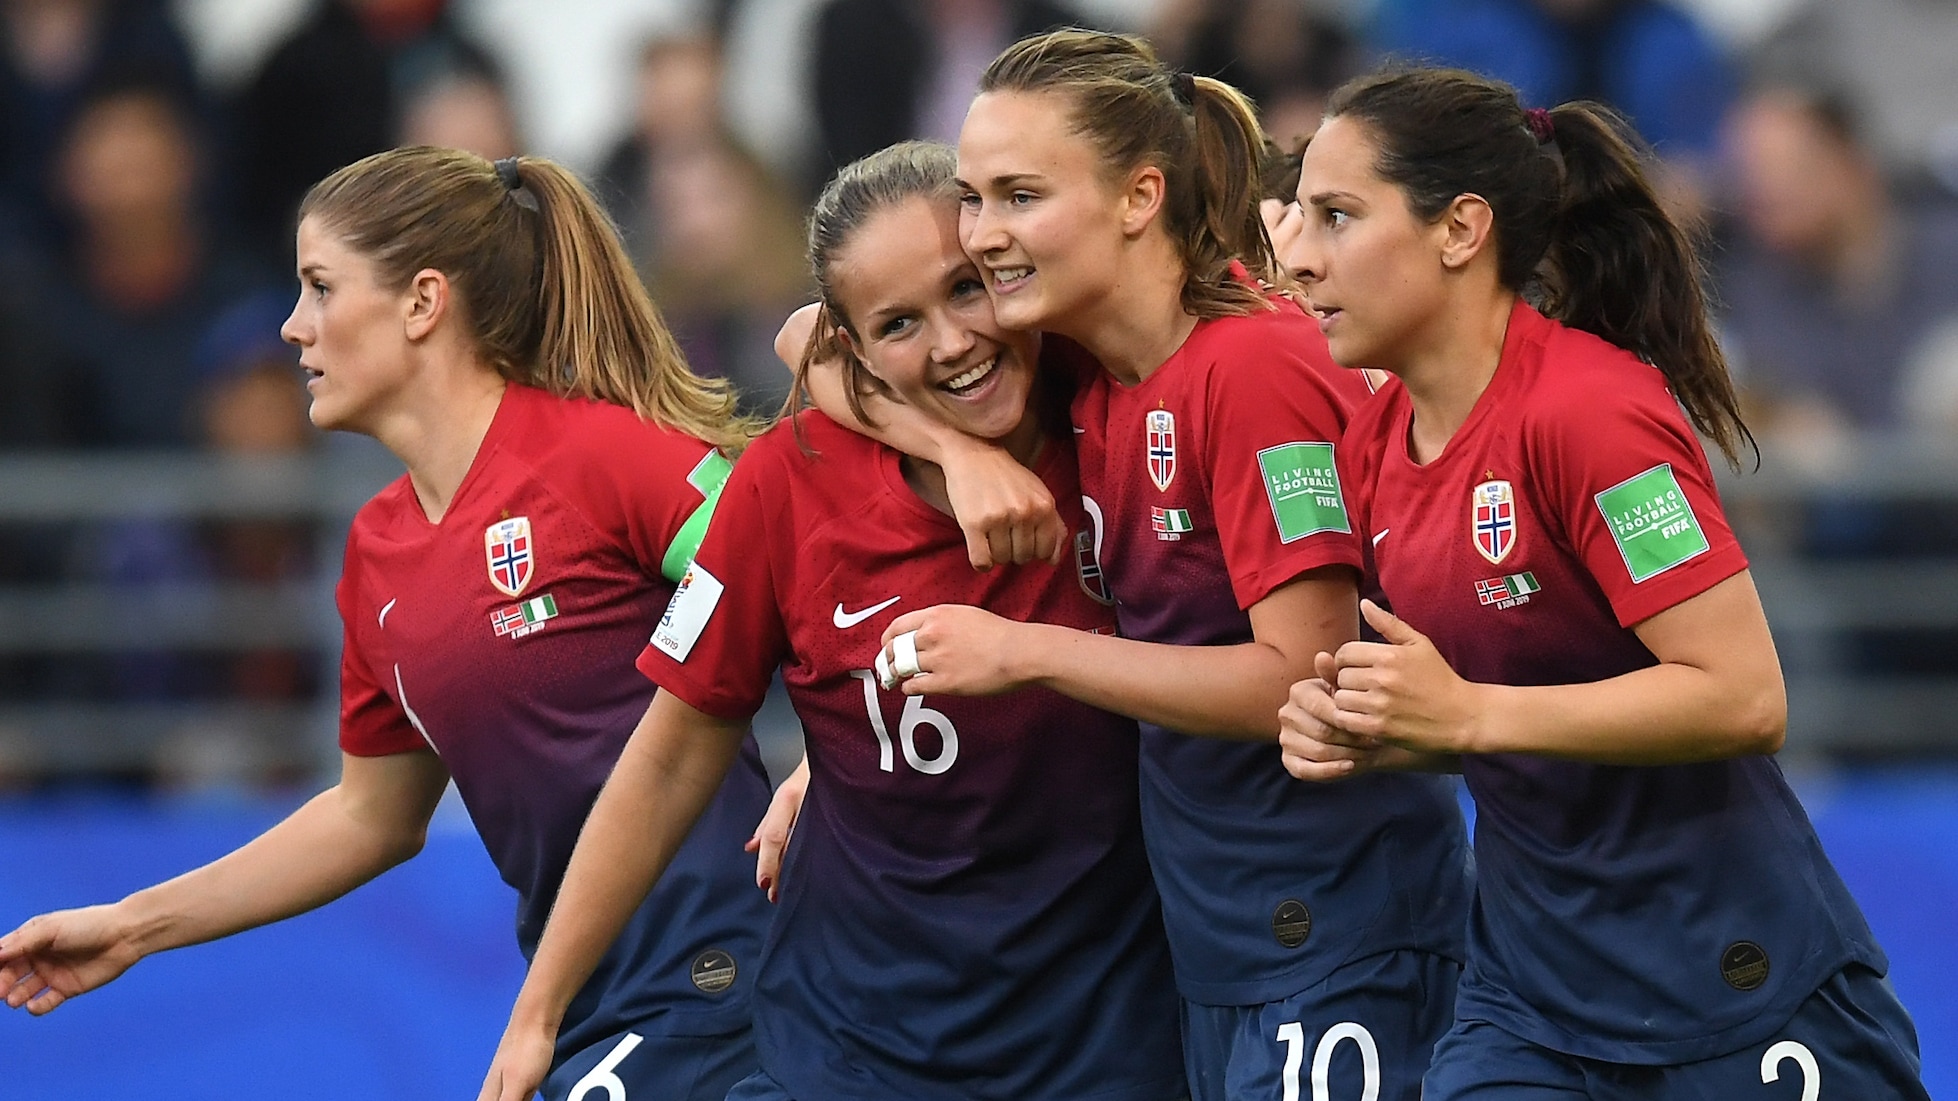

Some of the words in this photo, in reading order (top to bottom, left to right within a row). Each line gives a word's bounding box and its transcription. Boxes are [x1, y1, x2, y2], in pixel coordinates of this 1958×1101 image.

[1271, 467, 1332, 485] LIVING
[1274, 477, 1335, 494] FOOTBALL
[1315, 495, 1340, 508] FIFA
[1612, 490, 1677, 526] LIVING
[1617, 500, 1681, 535] FOOTBALL
[1661, 517, 1691, 540] FIFA
[660, 635, 679, 650] 2019
[850, 668, 959, 775] 16
[566, 1032, 644, 1101] 6
[1276, 1021, 1381, 1101] 10
[1760, 1040, 1821, 1101] 2
